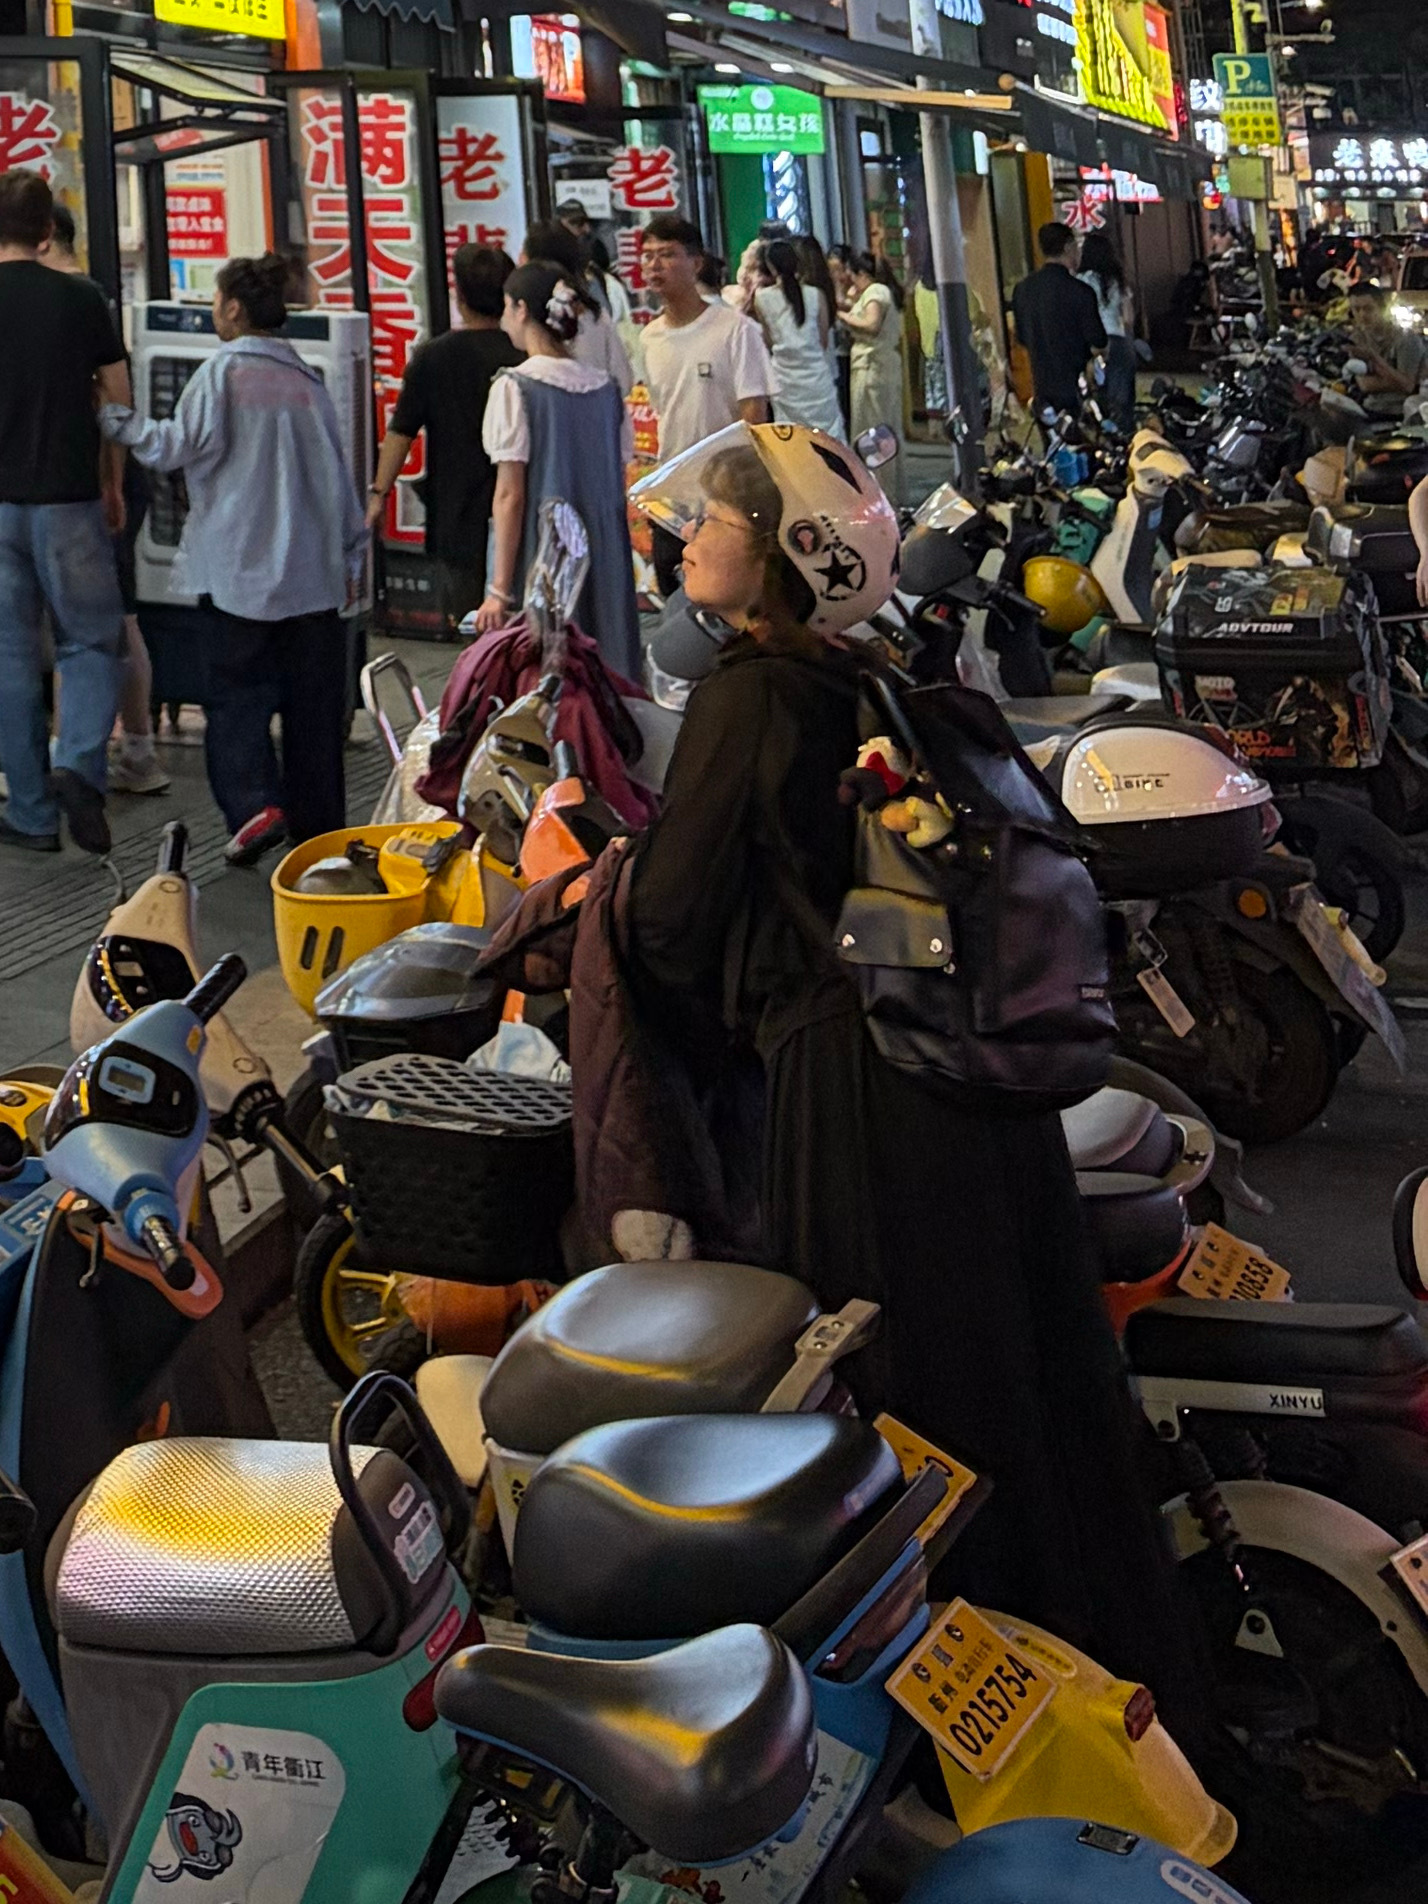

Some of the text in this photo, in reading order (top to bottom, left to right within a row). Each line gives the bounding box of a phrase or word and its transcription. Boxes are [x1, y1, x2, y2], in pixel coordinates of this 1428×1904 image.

[1222, 59, 1252, 95] P
[302, 94, 426, 547] 满天香
[1213, 621, 1294, 635] ADVTOUR
[1269, 1393, 1325, 1411] XINYU
[948, 1651, 1039, 1758] 0215754
[241, 1750, 327, 1781] 青年衢江
